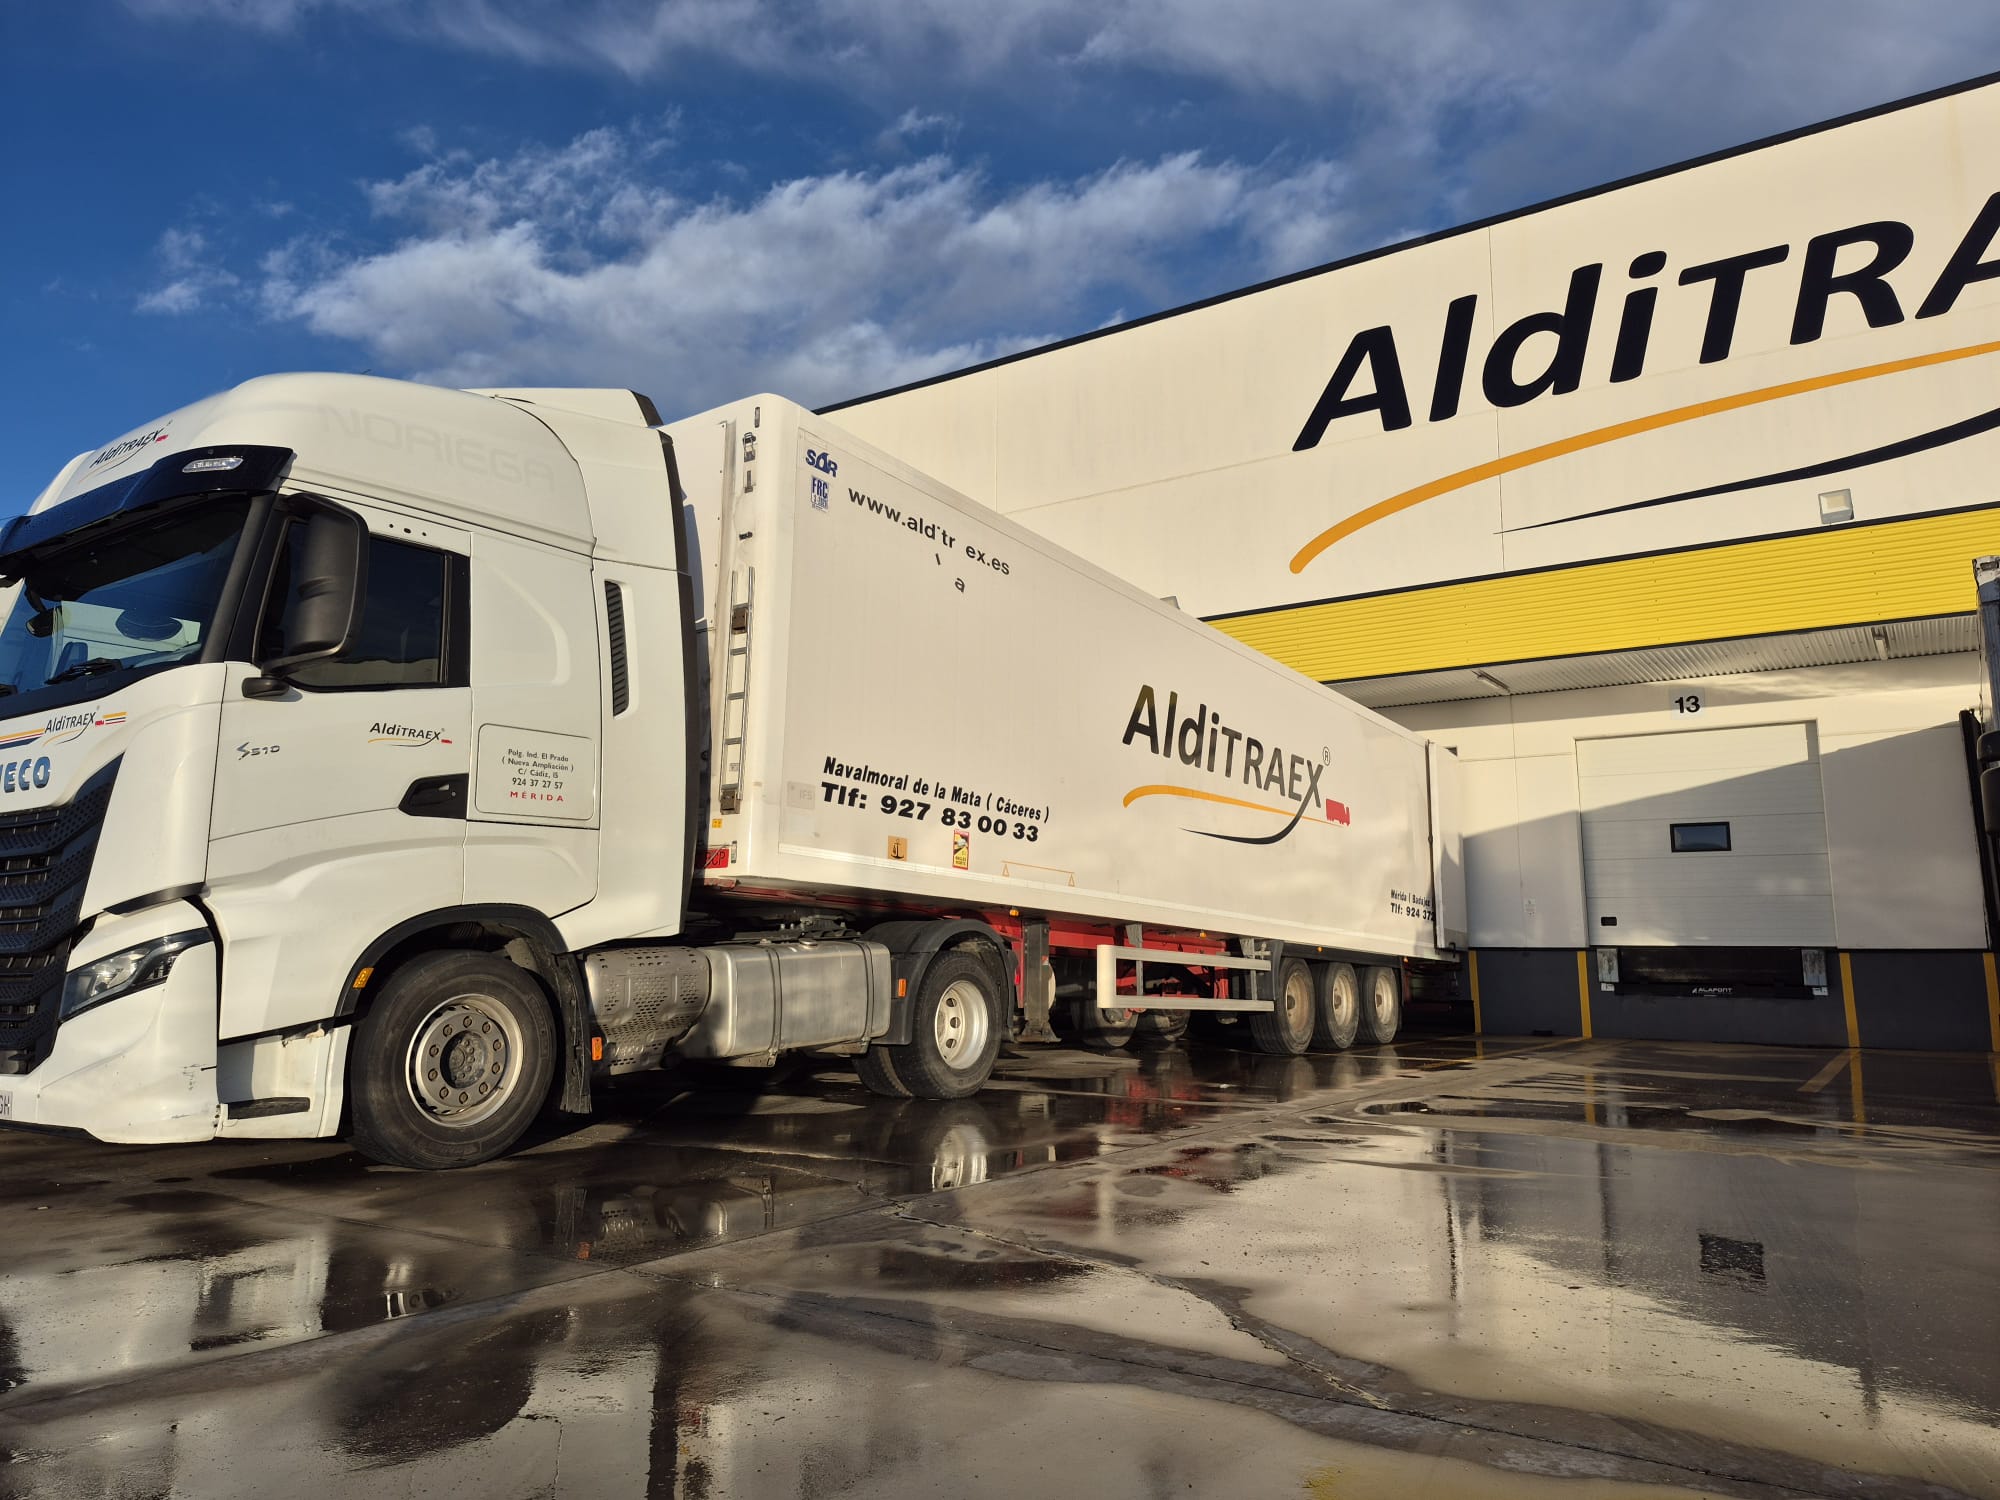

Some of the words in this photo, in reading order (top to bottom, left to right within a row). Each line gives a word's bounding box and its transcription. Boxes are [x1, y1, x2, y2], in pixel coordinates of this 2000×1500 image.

[318, 403, 556, 494] NORIEGA
[805, 448, 838, 478] SOR
[811, 477, 828, 499] FRC
[1675, 695, 1701, 714] 13
[508, 758, 530, 767] Nueva
[550, 753, 569, 762] Prado
[0, 756, 51, 794] ECO
[512, 777, 527, 786] 924
[530, 779, 539, 787] 37
[542, 780, 552, 789] 27
[554, 781, 564, 790] 57
[823, 756, 909, 791] Navalmoral
[913, 777, 930, 796] de
[934, 781, 946, 800] la
[951, 786, 982, 807] Mata
[996, 796, 1042, 822] Cáceres
[821, 781, 867, 810] Tlf:
[880, 795, 931, 821] 927
[941, 807, 972, 829] 83
[978, 815, 1007, 836] 00
[1013, 822, 1039, 843] 33
[1406, 906, 1420, 918] 924
